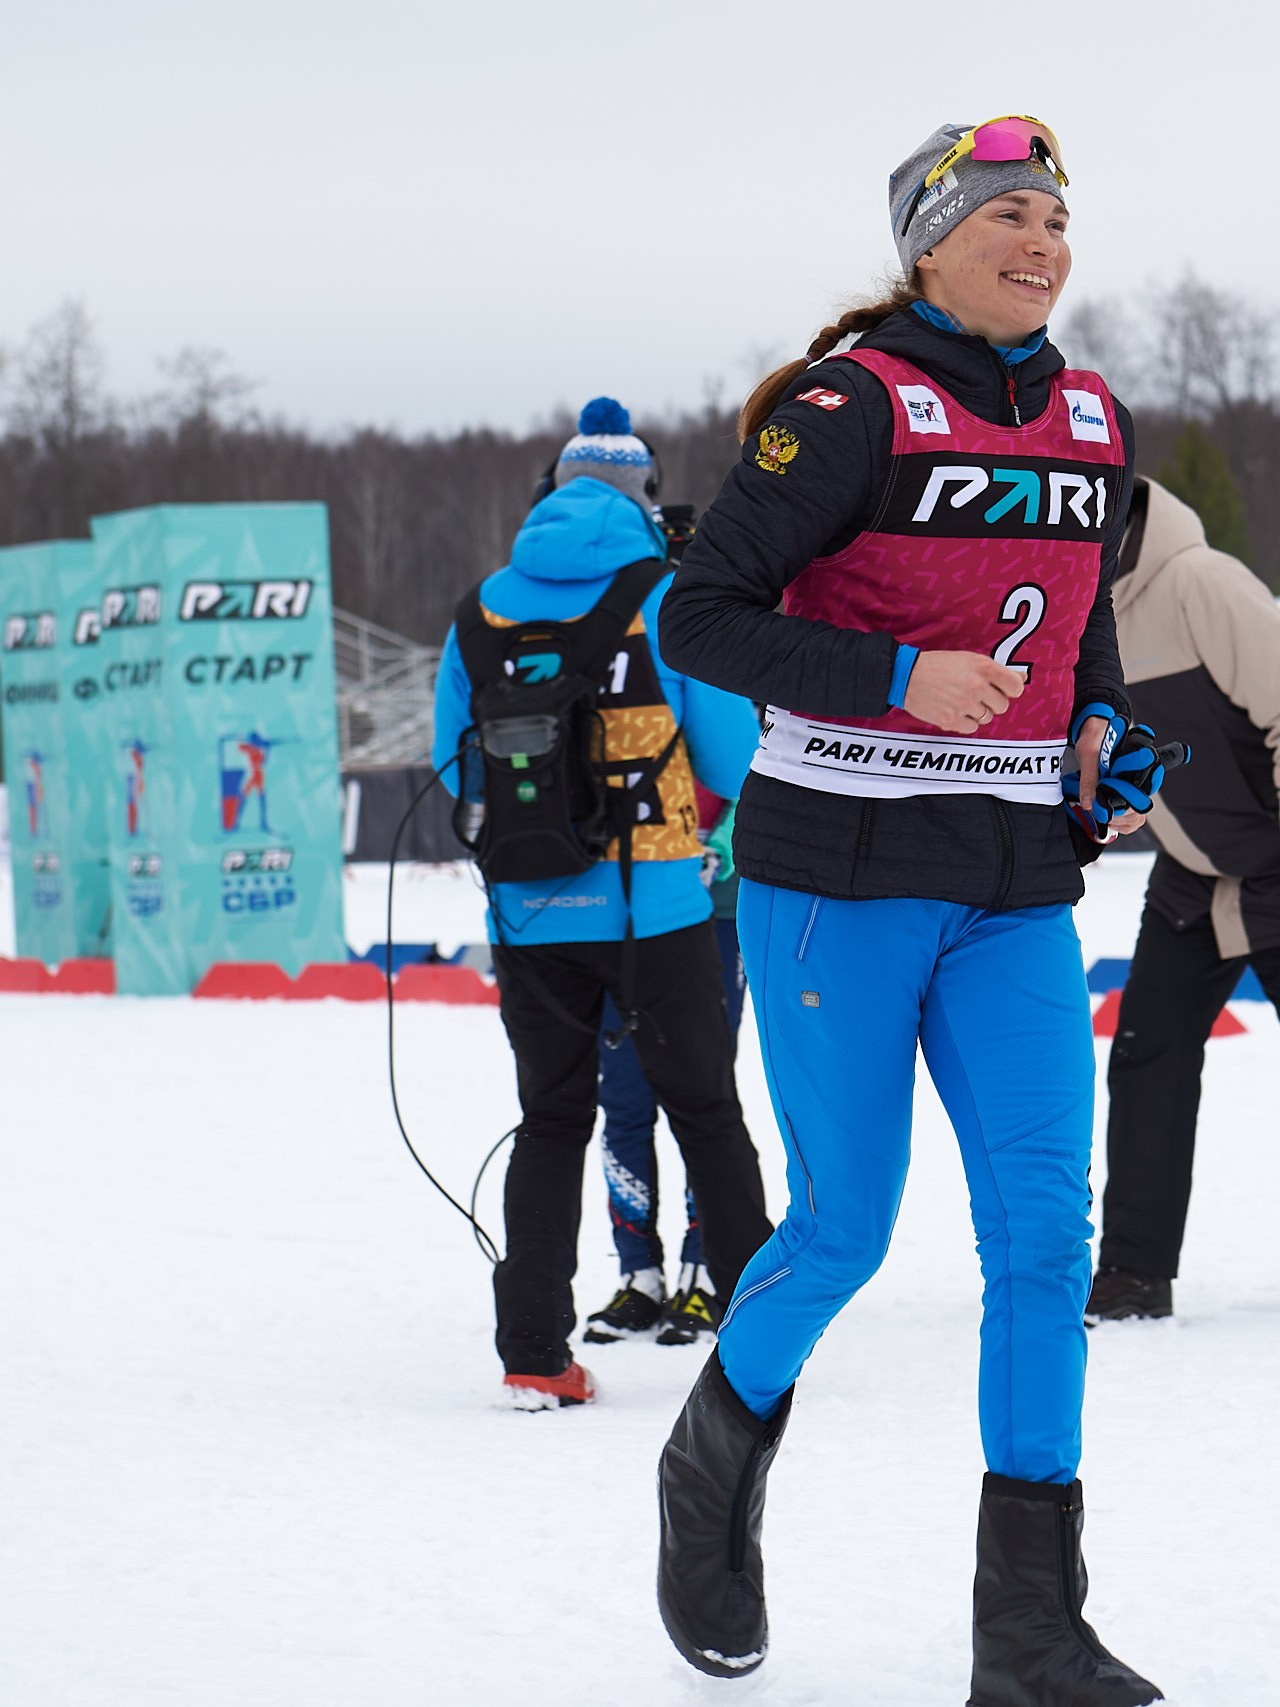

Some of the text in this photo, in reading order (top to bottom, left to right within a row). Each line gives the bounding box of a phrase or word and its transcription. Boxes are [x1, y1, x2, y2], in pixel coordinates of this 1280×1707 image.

[911, 466, 1107, 529] PARI
[181, 580, 311, 620] PARI
[990, 581, 1049, 685] 2
[105, 659, 162, 691] СТАРТ
[185, 653, 313, 685] СТАРТ
[804, 737, 877, 764] PARI
[883, 748, 1046, 775] ЧЕМПИОНАТ
